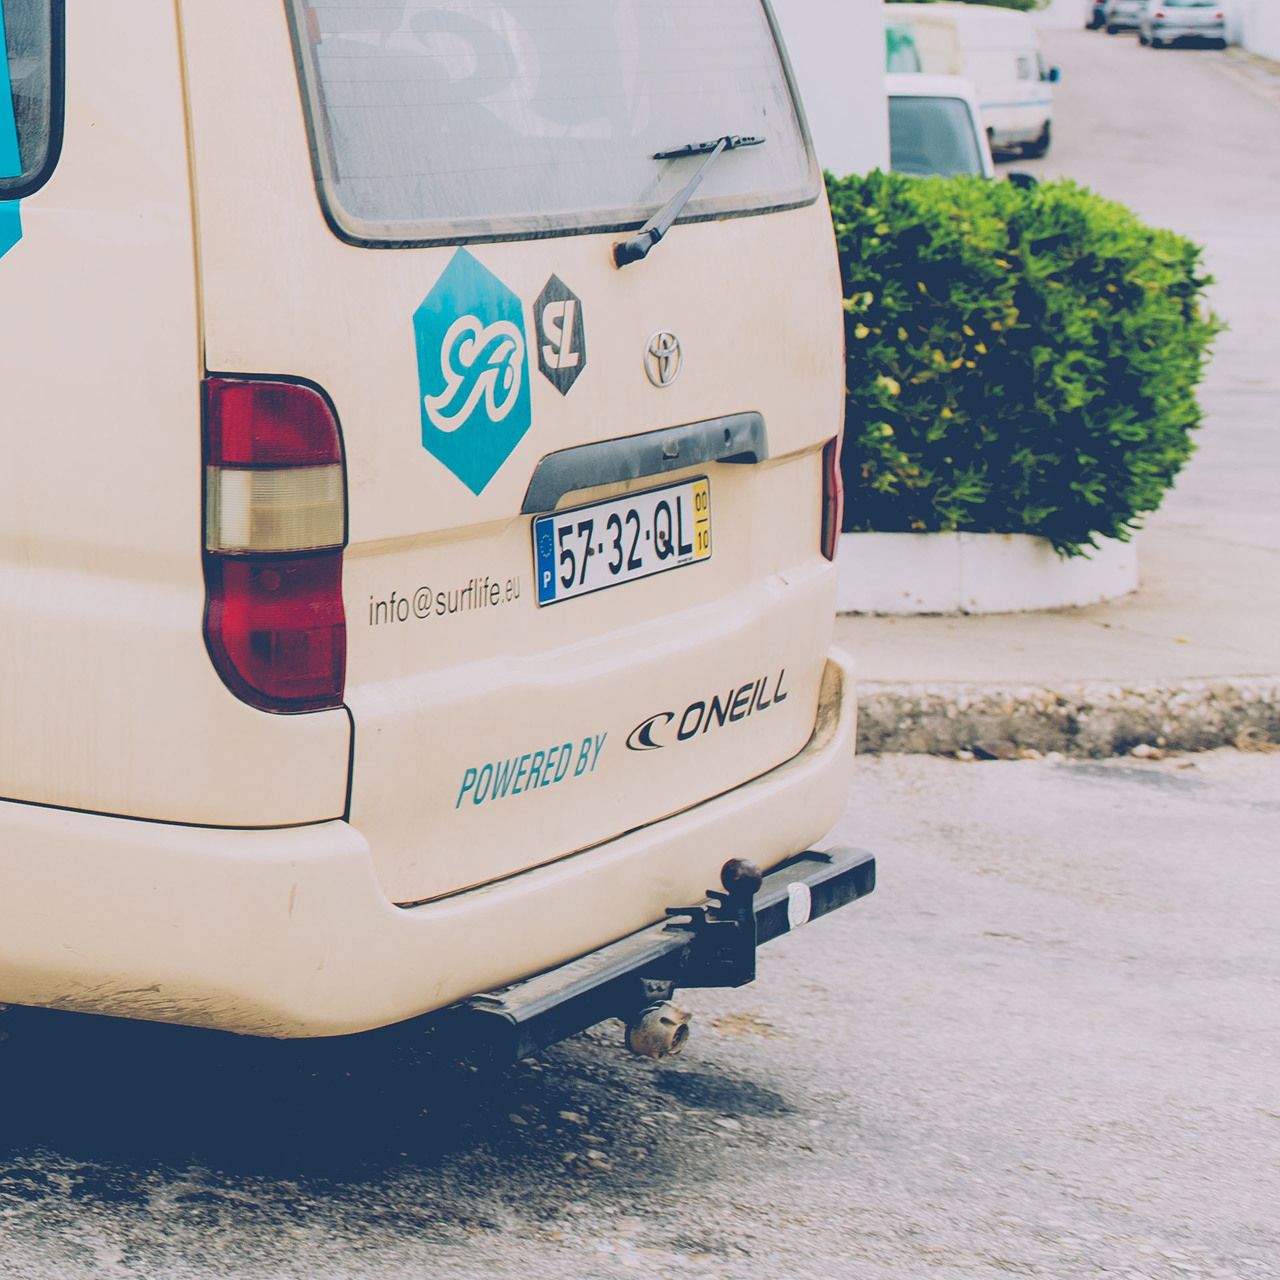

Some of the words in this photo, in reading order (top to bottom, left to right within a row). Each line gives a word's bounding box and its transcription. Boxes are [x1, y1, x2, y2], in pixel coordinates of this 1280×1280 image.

[369, 575, 521, 626] info@surflife.eu
[455, 742, 574, 809] POWERED
[574, 732, 608, 778] BY
[677, 668, 789, 742] ONEILL
